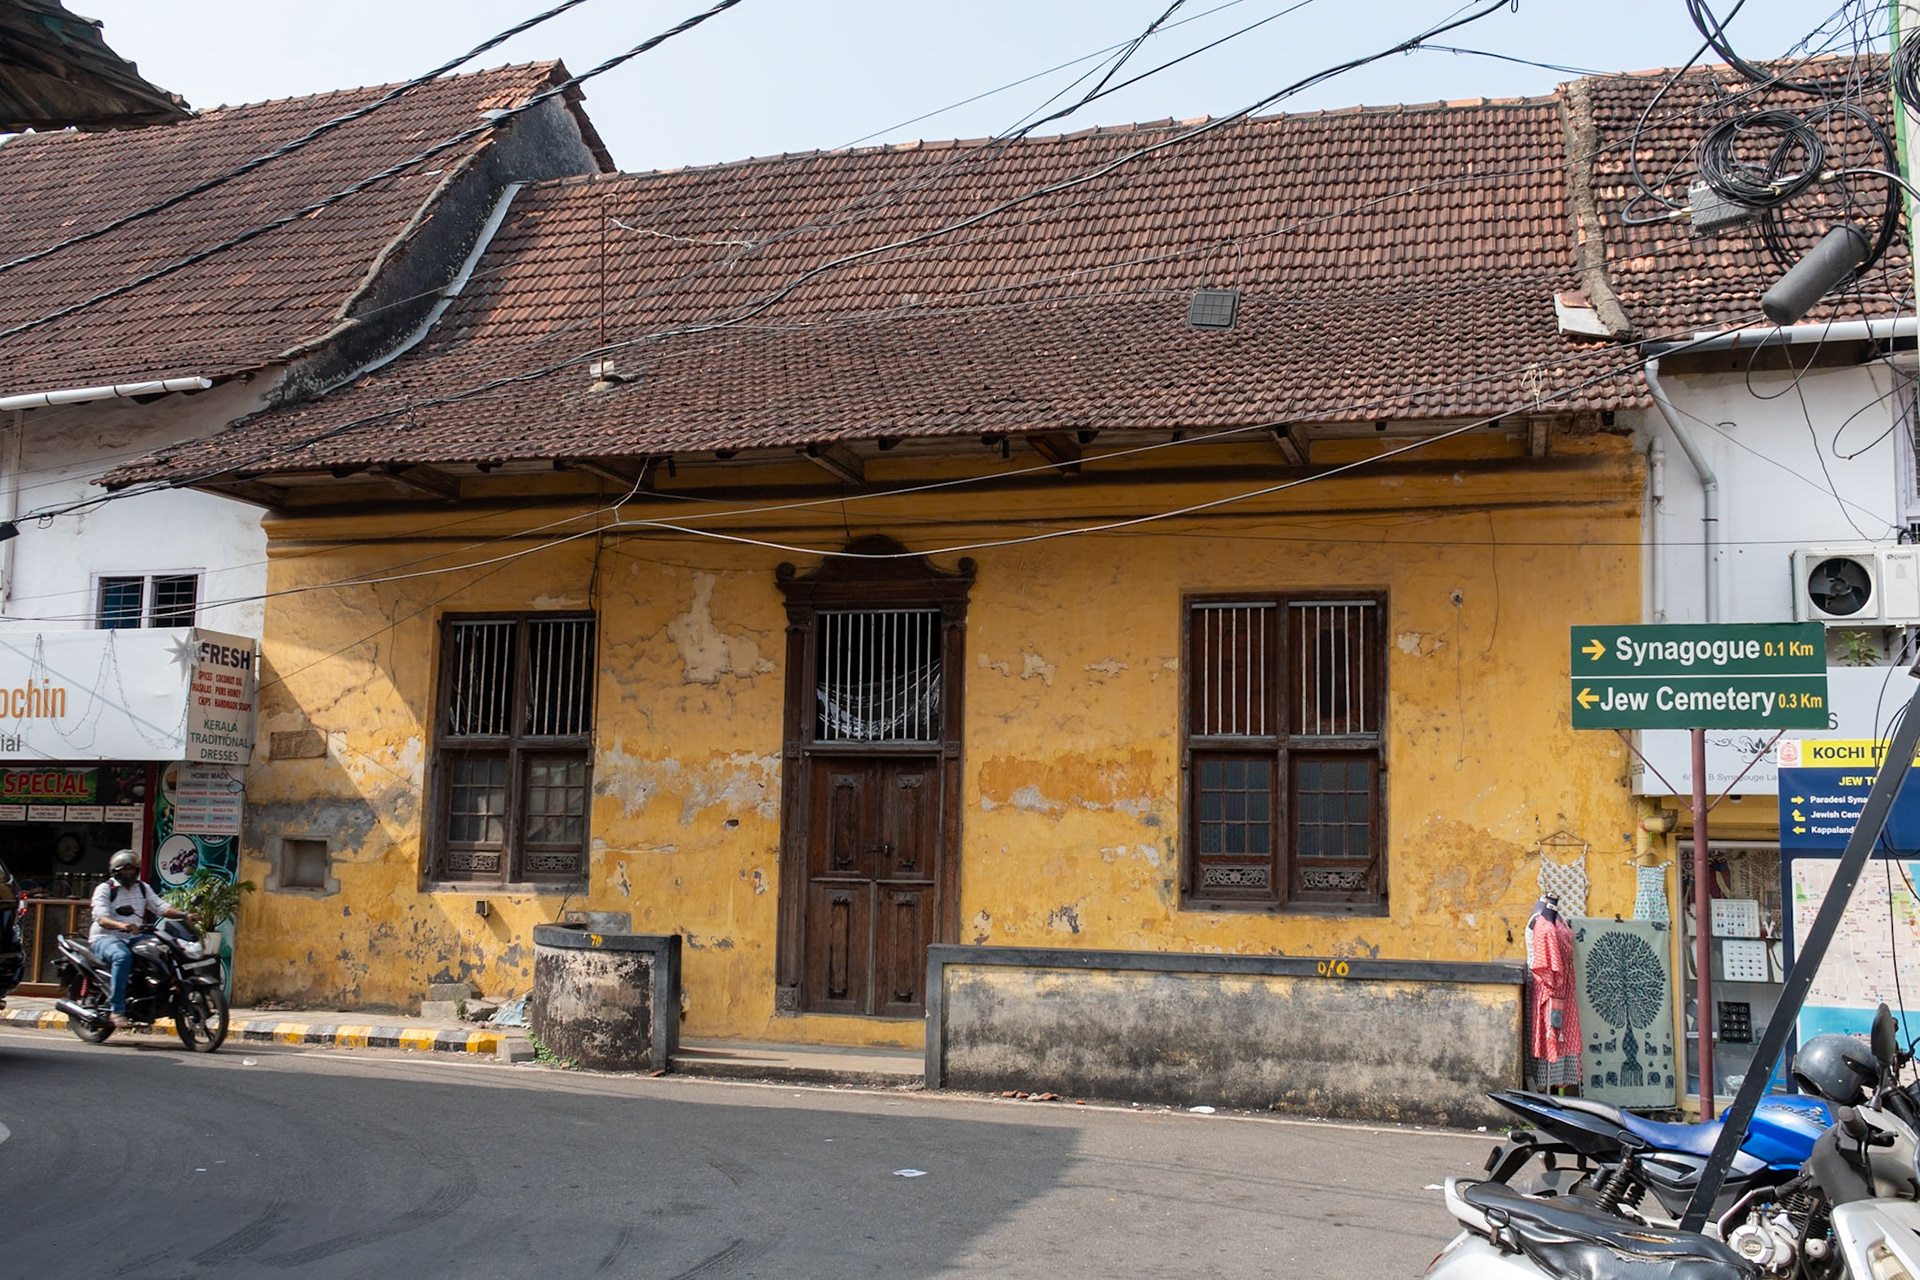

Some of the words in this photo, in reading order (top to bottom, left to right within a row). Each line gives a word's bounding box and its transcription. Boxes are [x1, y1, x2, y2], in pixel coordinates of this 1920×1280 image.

[201, 642, 251, 670] FRESH
[1615, 636, 1761, 666] Synagogue
[1764, 641, 1784, 657] 0.1
[1789, 641, 1814, 656] Km
[198, 670, 212, 681] SPICES
[215, 674, 235, 686] COCONUT
[215, 685, 226, 697] PURE
[227, 687, 241, 698] HONEY
[198, 696, 211, 707] CHIPS
[1600, 687, 1649, 711] Jew
[1656, 686, 1776, 716] Cemetery
[1778, 694, 1798, 708] 0.3
[1801, 694, 1823, 708] Km
[203, 719, 238, 732] KERALA
[190, 732, 249, 748] TRADITIONAL
[200, 748, 239, 762] DRESSES
[1813, 746, 1865, 759] KOCHI
[191, 772, 209, 780] HOME
[211, 772, 229, 780] MADE
[1838, 776, 1863, 786] JEW
[3, 772, 89, 794] SPECIAL
[1810, 796, 1846, 804] Paradesi
[1847, 796, 1868, 805] Syna
[1811, 826, 1856, 835] Kappaland
